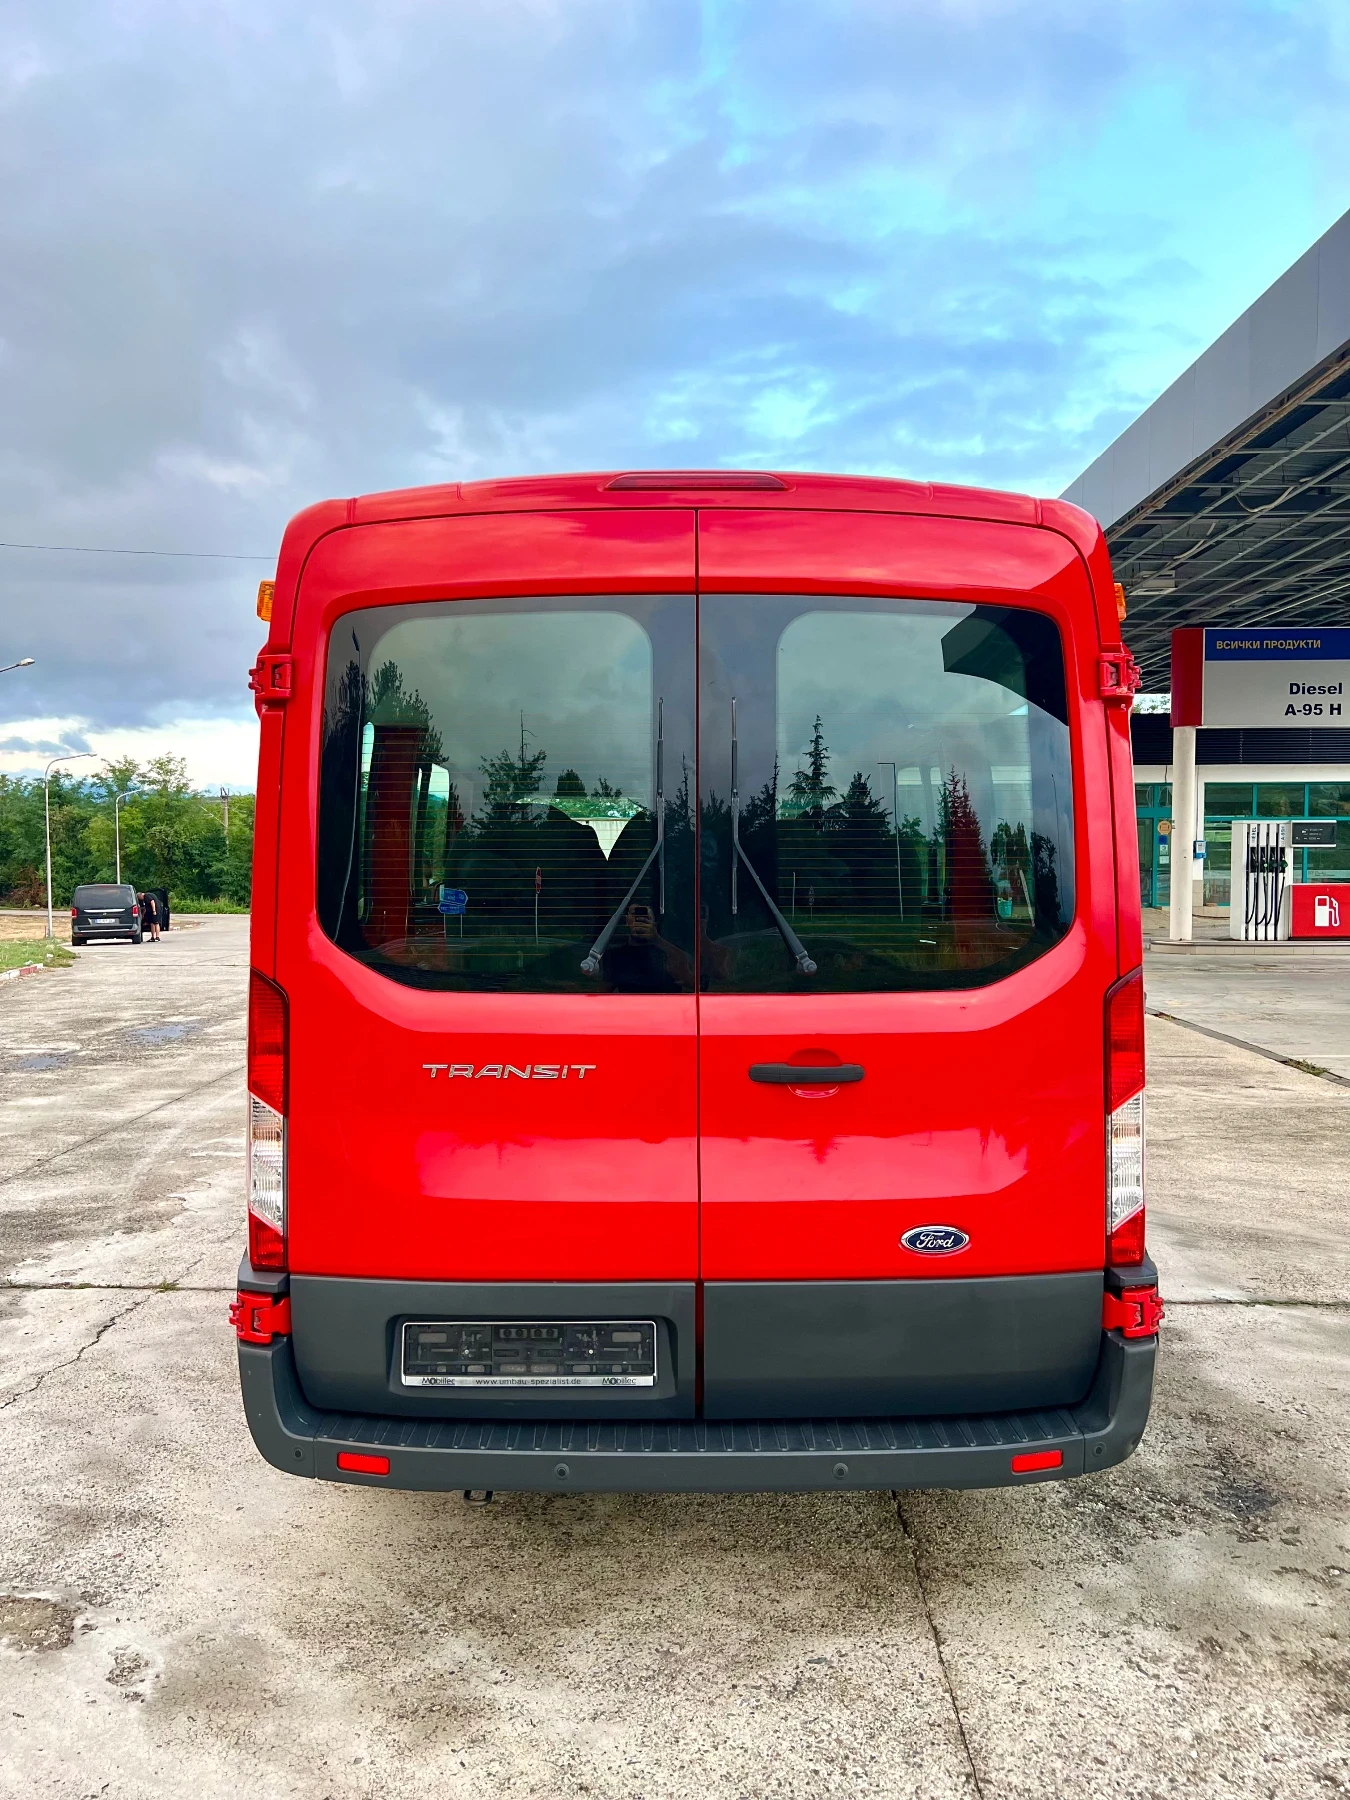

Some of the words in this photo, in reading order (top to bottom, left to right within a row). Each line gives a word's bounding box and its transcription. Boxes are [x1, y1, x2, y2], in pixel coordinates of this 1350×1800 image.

[1216, 640, 1260, 650] ВСИЧКИ
[1263, 639, 1321, 649] ПРОДУКТИ
[1289, 682, 1343, 695] Diesel
[1284, 703, 1323, 716] A-95
[422, 1064, 597, 1079] TRANSIT
[916, 1231, 955, 1249] Ford
